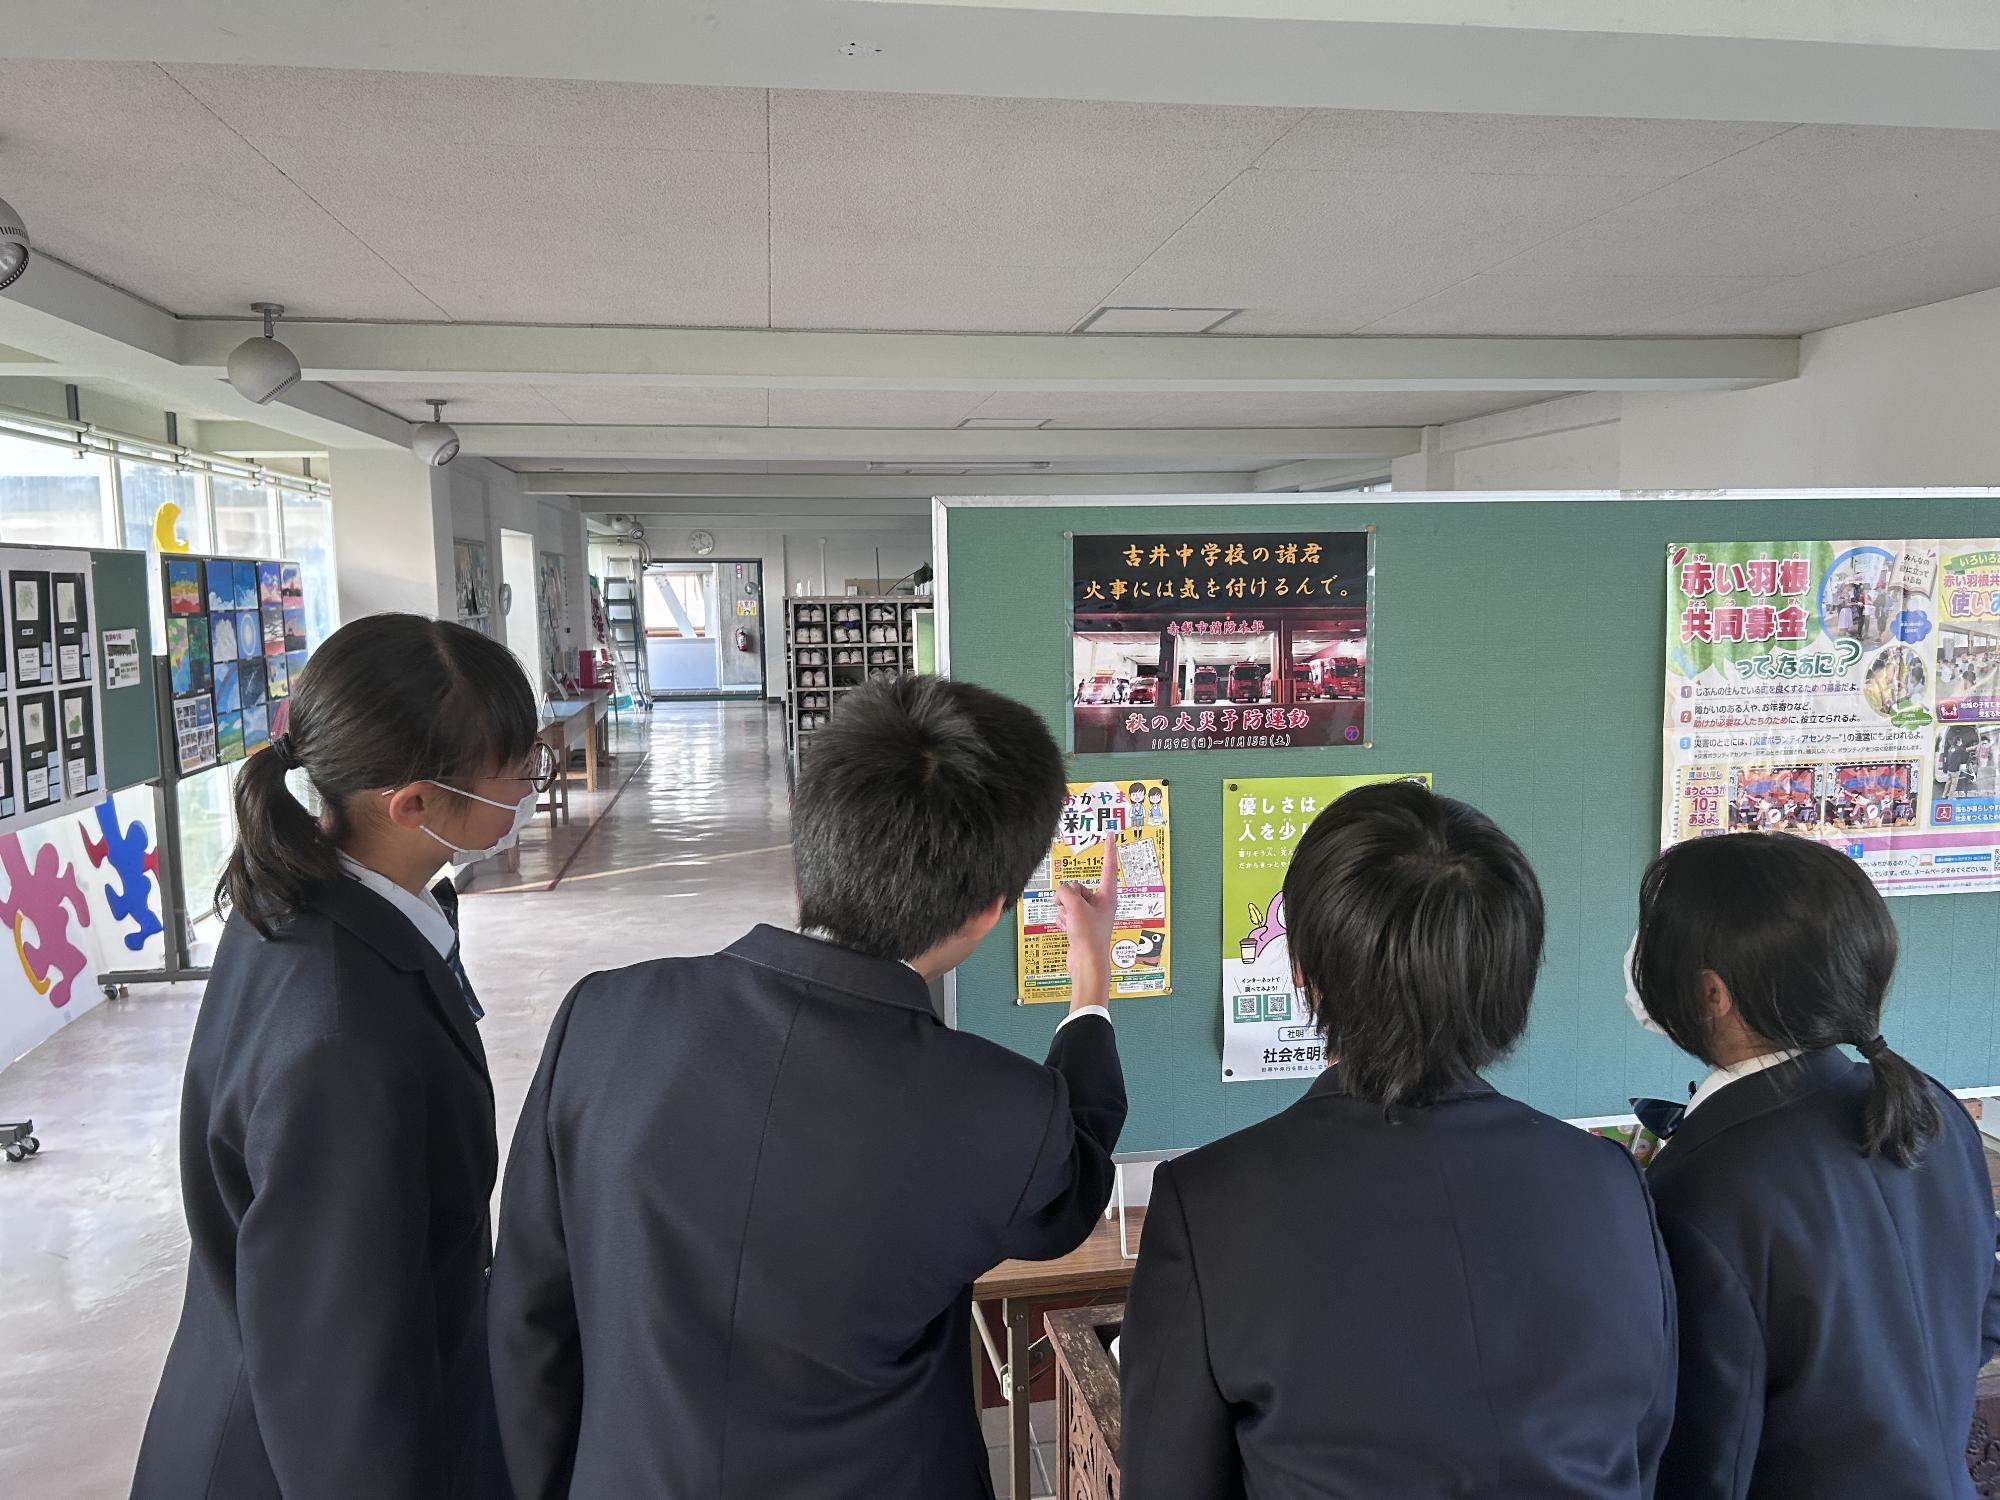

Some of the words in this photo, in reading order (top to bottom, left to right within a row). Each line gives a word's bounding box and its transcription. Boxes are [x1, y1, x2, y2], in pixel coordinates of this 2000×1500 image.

[1122, 544, 1323, 568] 吉井中学校の諸君
[1083, 575, 1350, 600] 火事には気を付けるんで。
[1681, 560, 1810, 597] 赤い羽根
[1681, 606, 1808, 643] 共同募金
[1126, 708, 1310, 733] 秋の火災予防運動
[1062, 791, 1127, 806] おかやま
[1063, 807, 1126, 834] 新聞
[1064, 833, 1127, 846] コンクル
